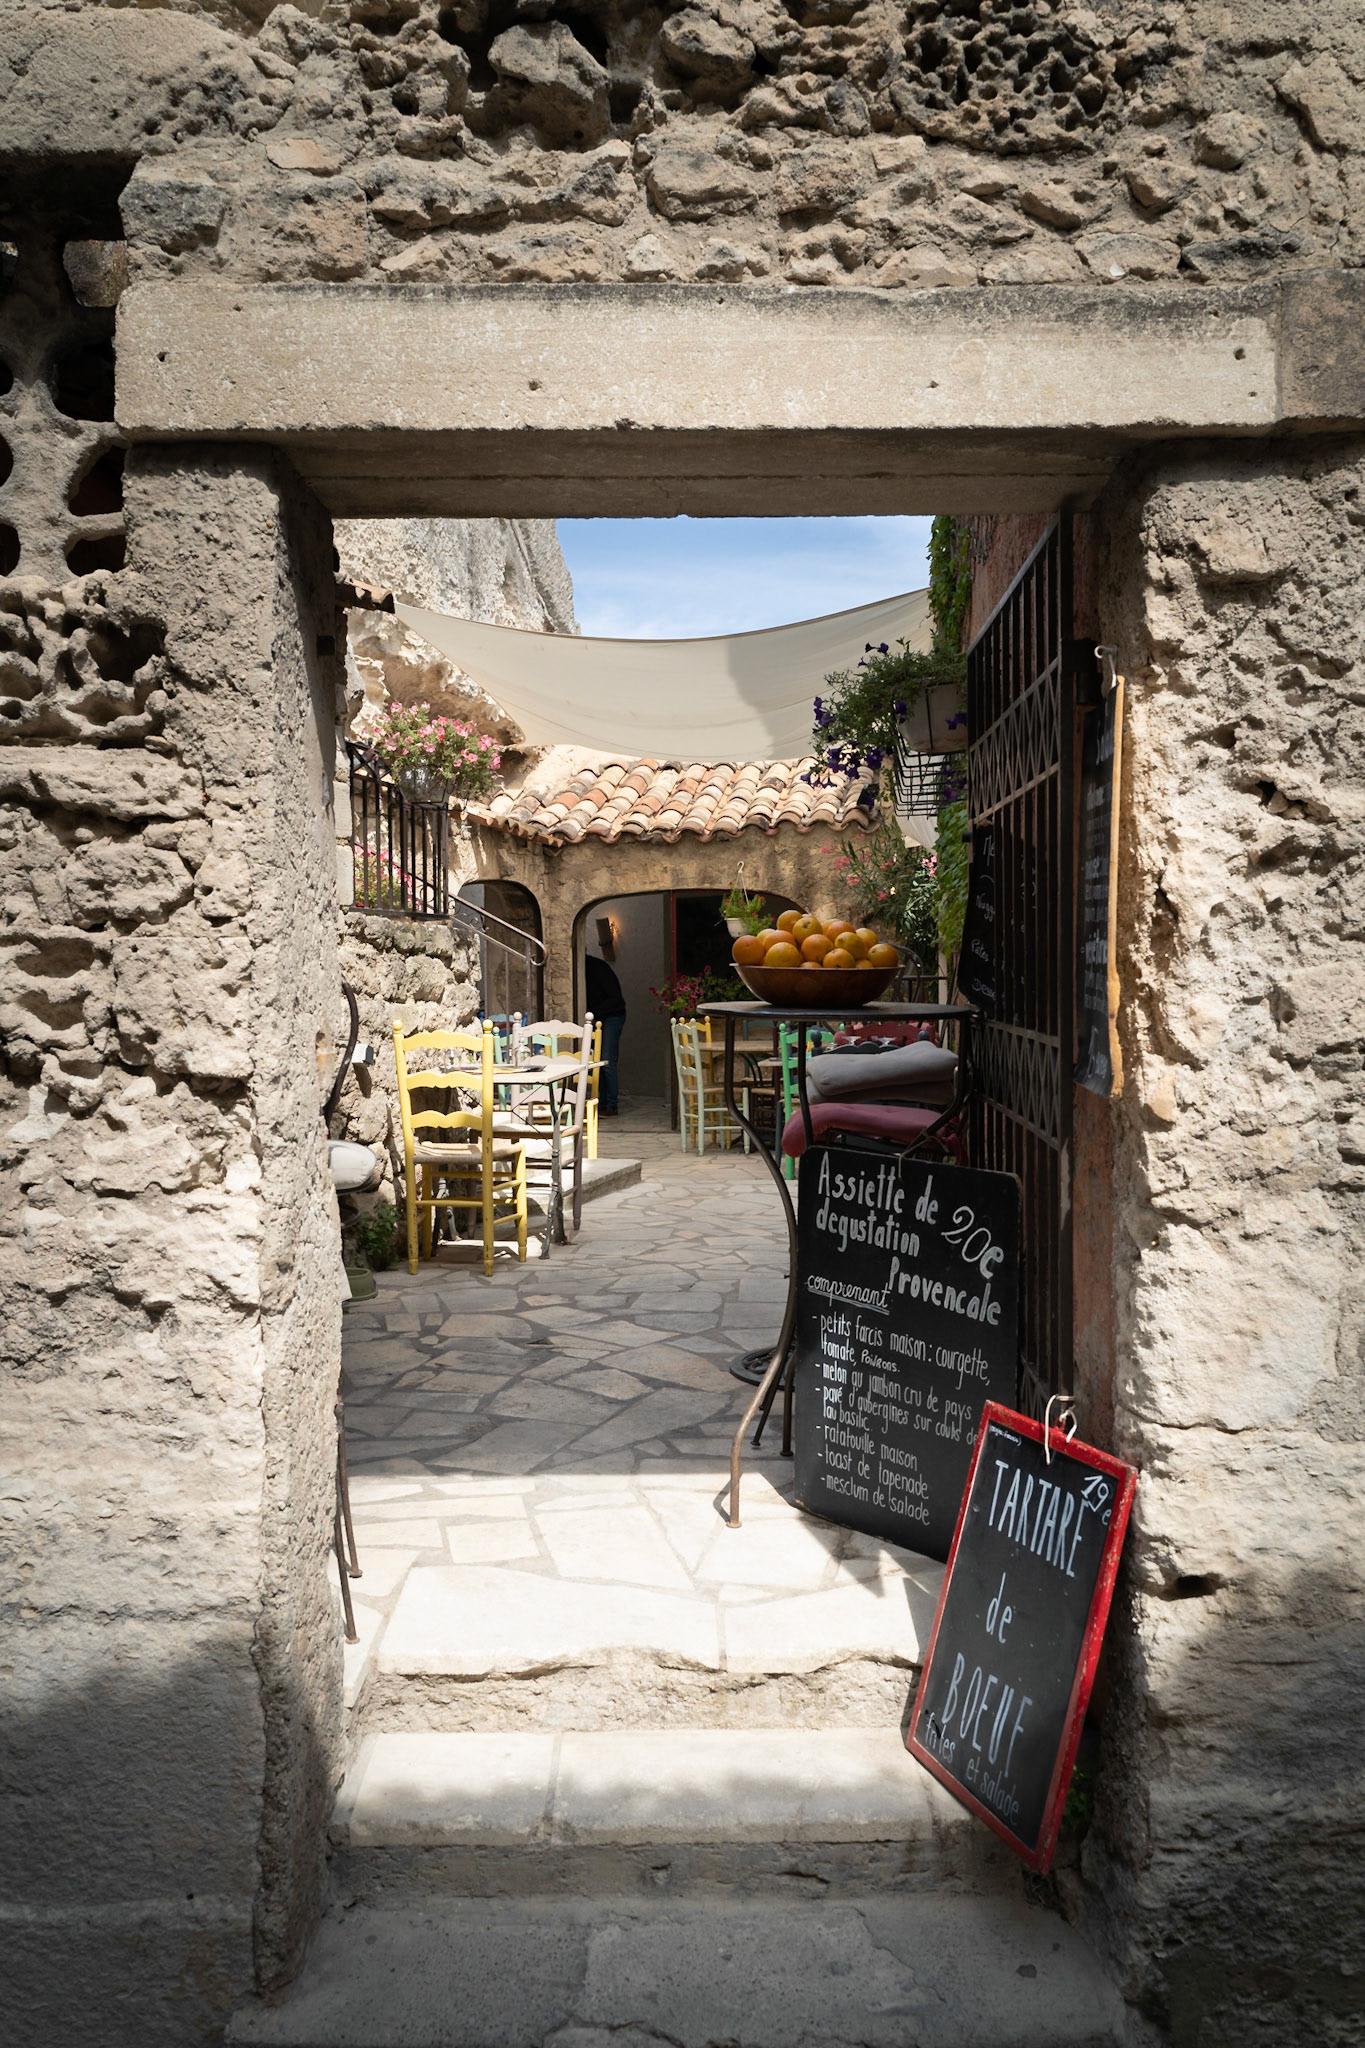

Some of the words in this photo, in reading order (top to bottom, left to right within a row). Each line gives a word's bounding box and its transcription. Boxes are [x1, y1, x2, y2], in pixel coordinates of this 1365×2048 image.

[818, 1151, 905, 1214] Assiette
[915, 1174, 938, 1225] de
[816, 1196, 921, 1257] degustation
[888, 1256, 1002, 1326] Provencale
[855, 1315, 883, 1347] farcis
[935, 1346, 991, 1391] courgette,
[822, 1360, 848, 1384] melon
[867, 1371, 902, 1400] jambon
[904, 1386, 922, 1407] cru
[926, 1386, 939, 1413] de
[944, 1399, 972, 1432] pays
[914, 1413, 932, 1432] sur
[824, 1422, 876, 1456] ratatouille
[880, 1443, 918, 1472] maison
[857, 1453, 871, 1480] de
[878, 1461, 930, 1502] tapenade
[872, 1485, 886, 1508] de
[889, 1496, 931, 1526] salade
[988, 1459, 1090, 1578] TARTARE
[984, 1571, 1014, 1645] de
[941, 1652, 1033, 1779] BOEUF
[965, 1756, 981, 1784] et
[980, 1770, 1020, 1827] salade
